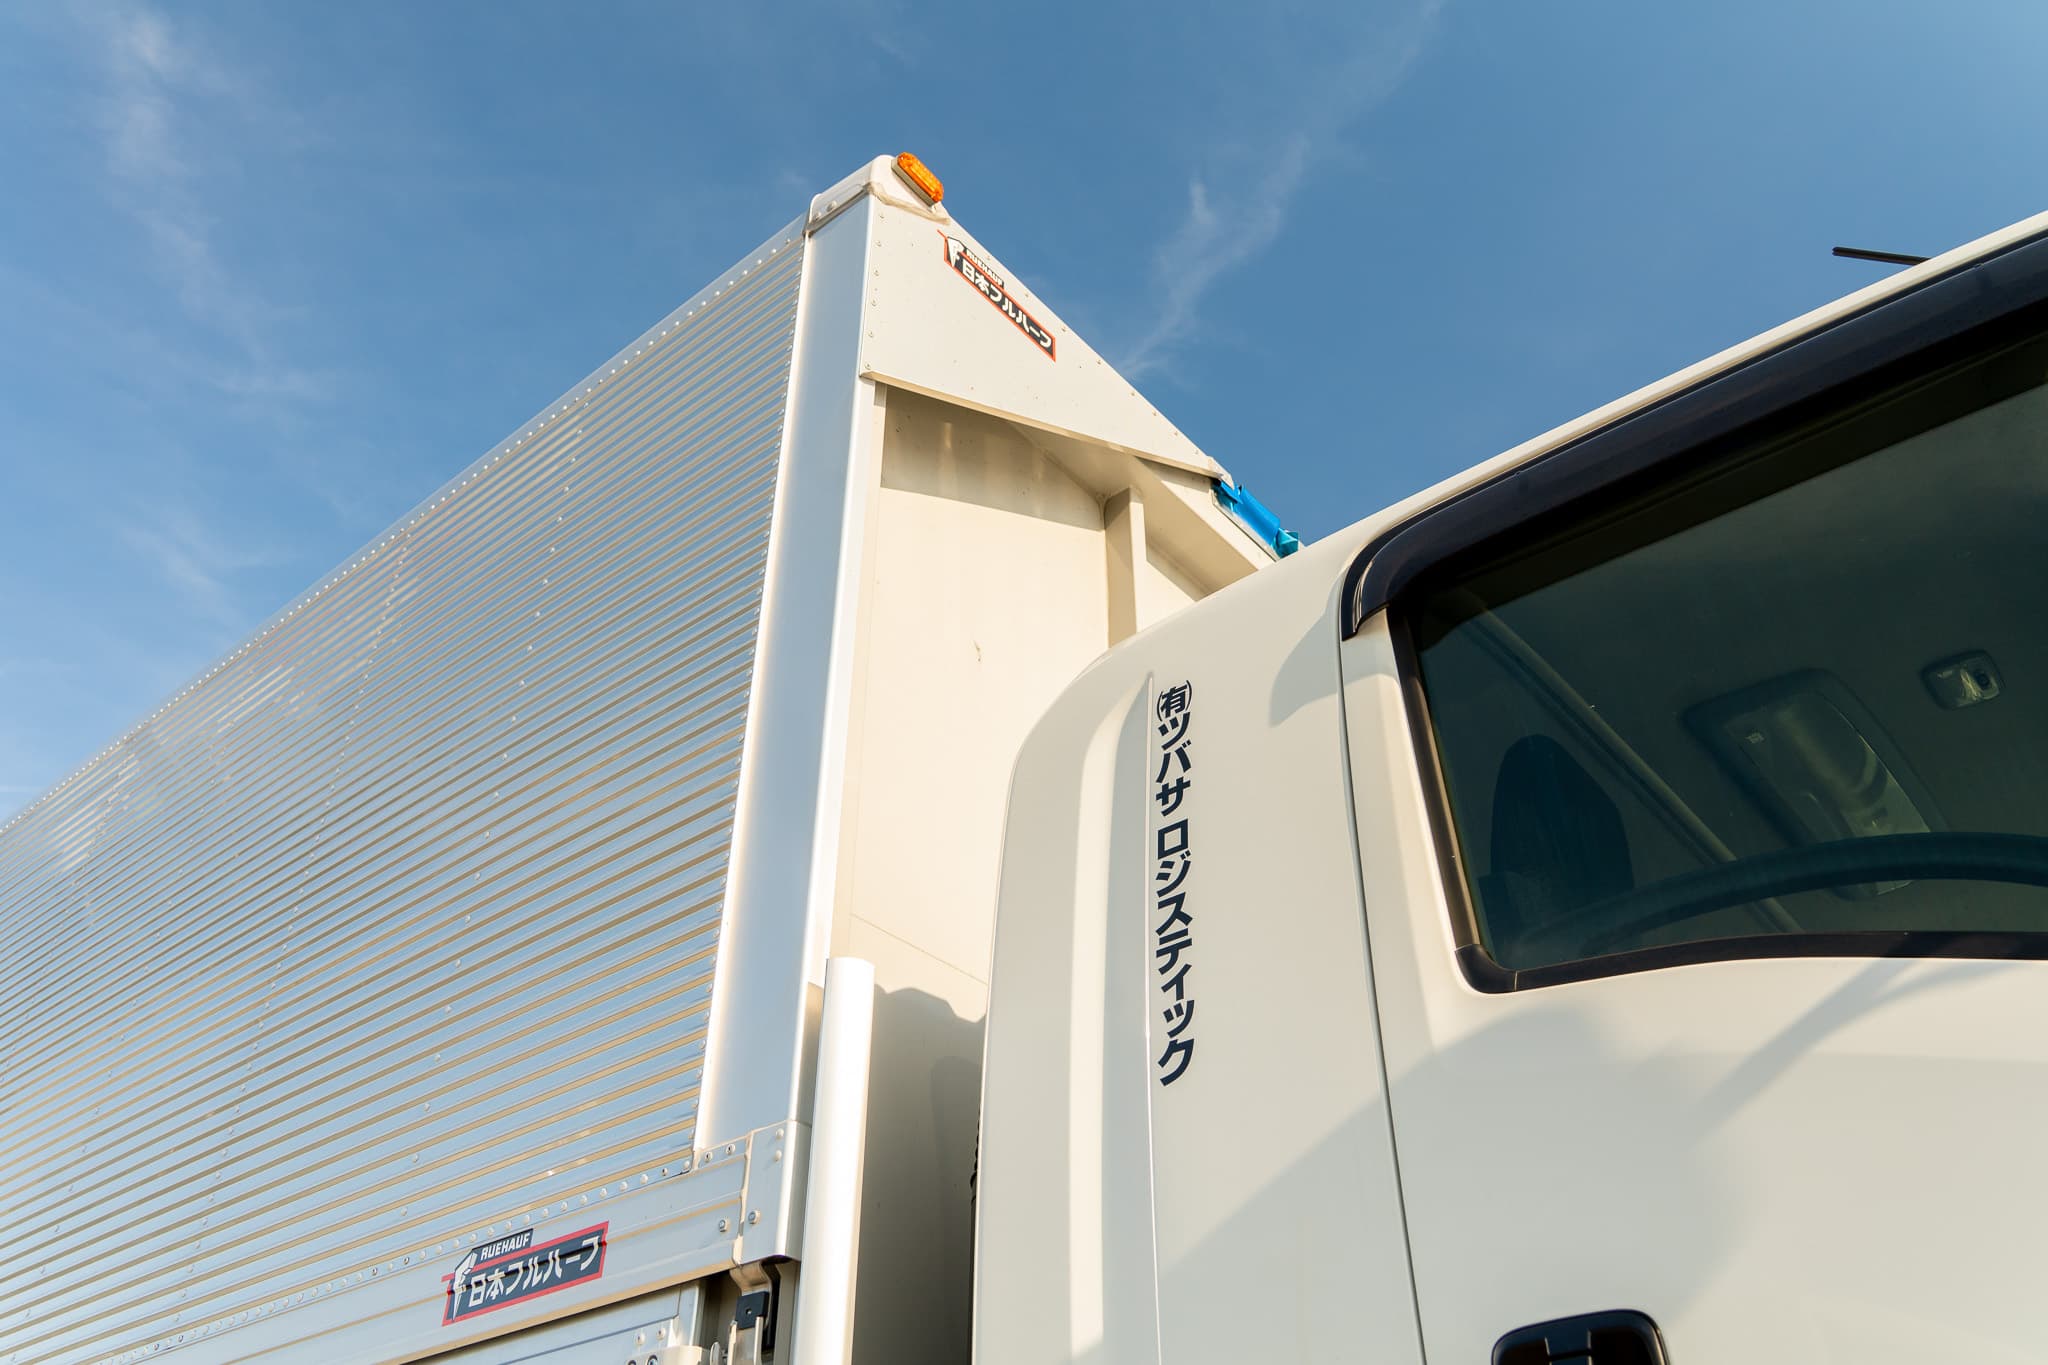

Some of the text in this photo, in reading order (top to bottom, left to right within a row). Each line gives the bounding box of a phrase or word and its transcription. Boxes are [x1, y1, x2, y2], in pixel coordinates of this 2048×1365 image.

[962, 257, 1052, 348] 日本フルハーフ
[468, 1235, 600, 1308] 日本フルハーフ
